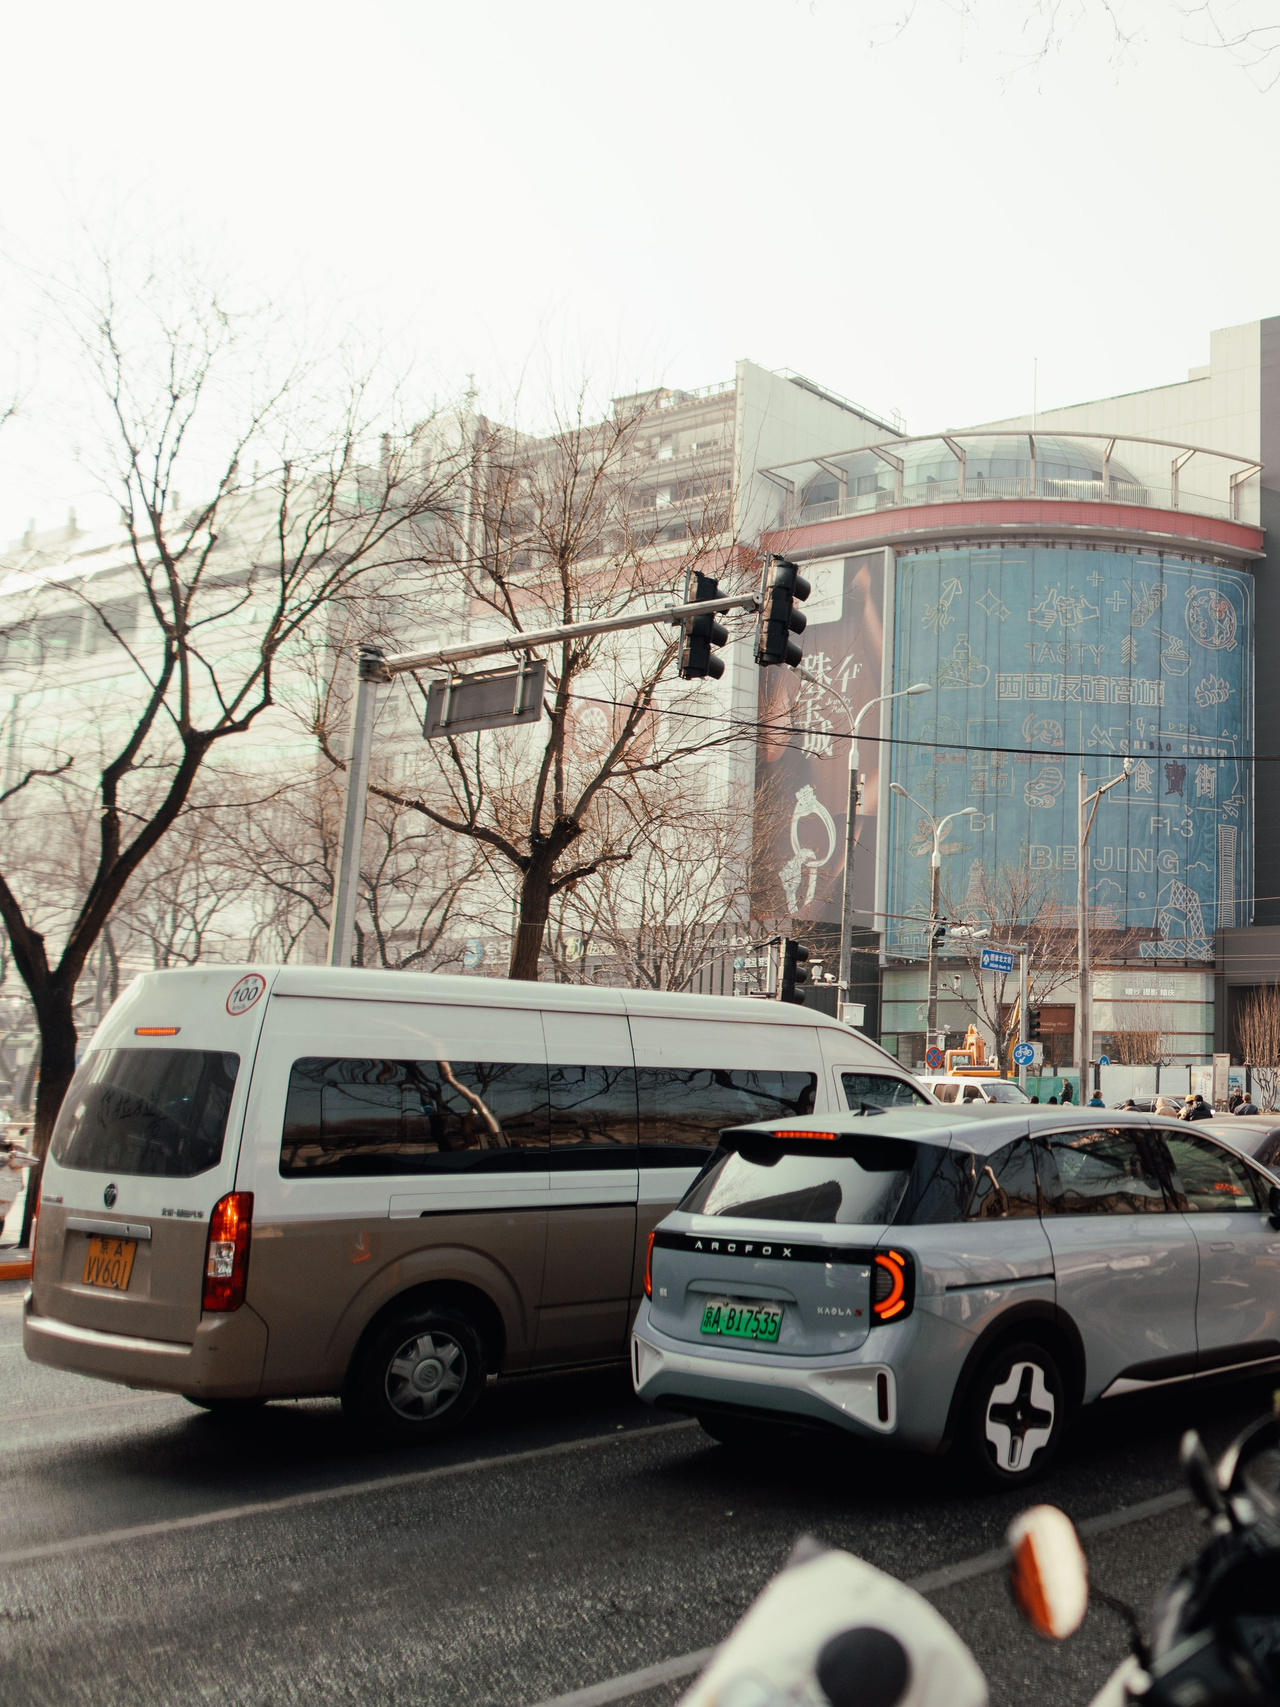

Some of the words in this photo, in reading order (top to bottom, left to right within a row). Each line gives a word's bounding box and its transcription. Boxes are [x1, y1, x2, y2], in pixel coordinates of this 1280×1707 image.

[1024, 642, 1106, 666] TASTY
[835, 653, 863, 693] 4F
[995, 673, 1166, 707] 西西友谊商城
[1182, 744, 1227, 767] STREET
[969, 813, 995, 832] B1
[1150, 816, 1194, 838] F1-3
[233, 986, 259, 1003] 100
[694, 1239, 792, 1258] ARCFOX
[86, 1255, 128, 1286] VV601
[817, 1306, 852, 1316] KAOLA
